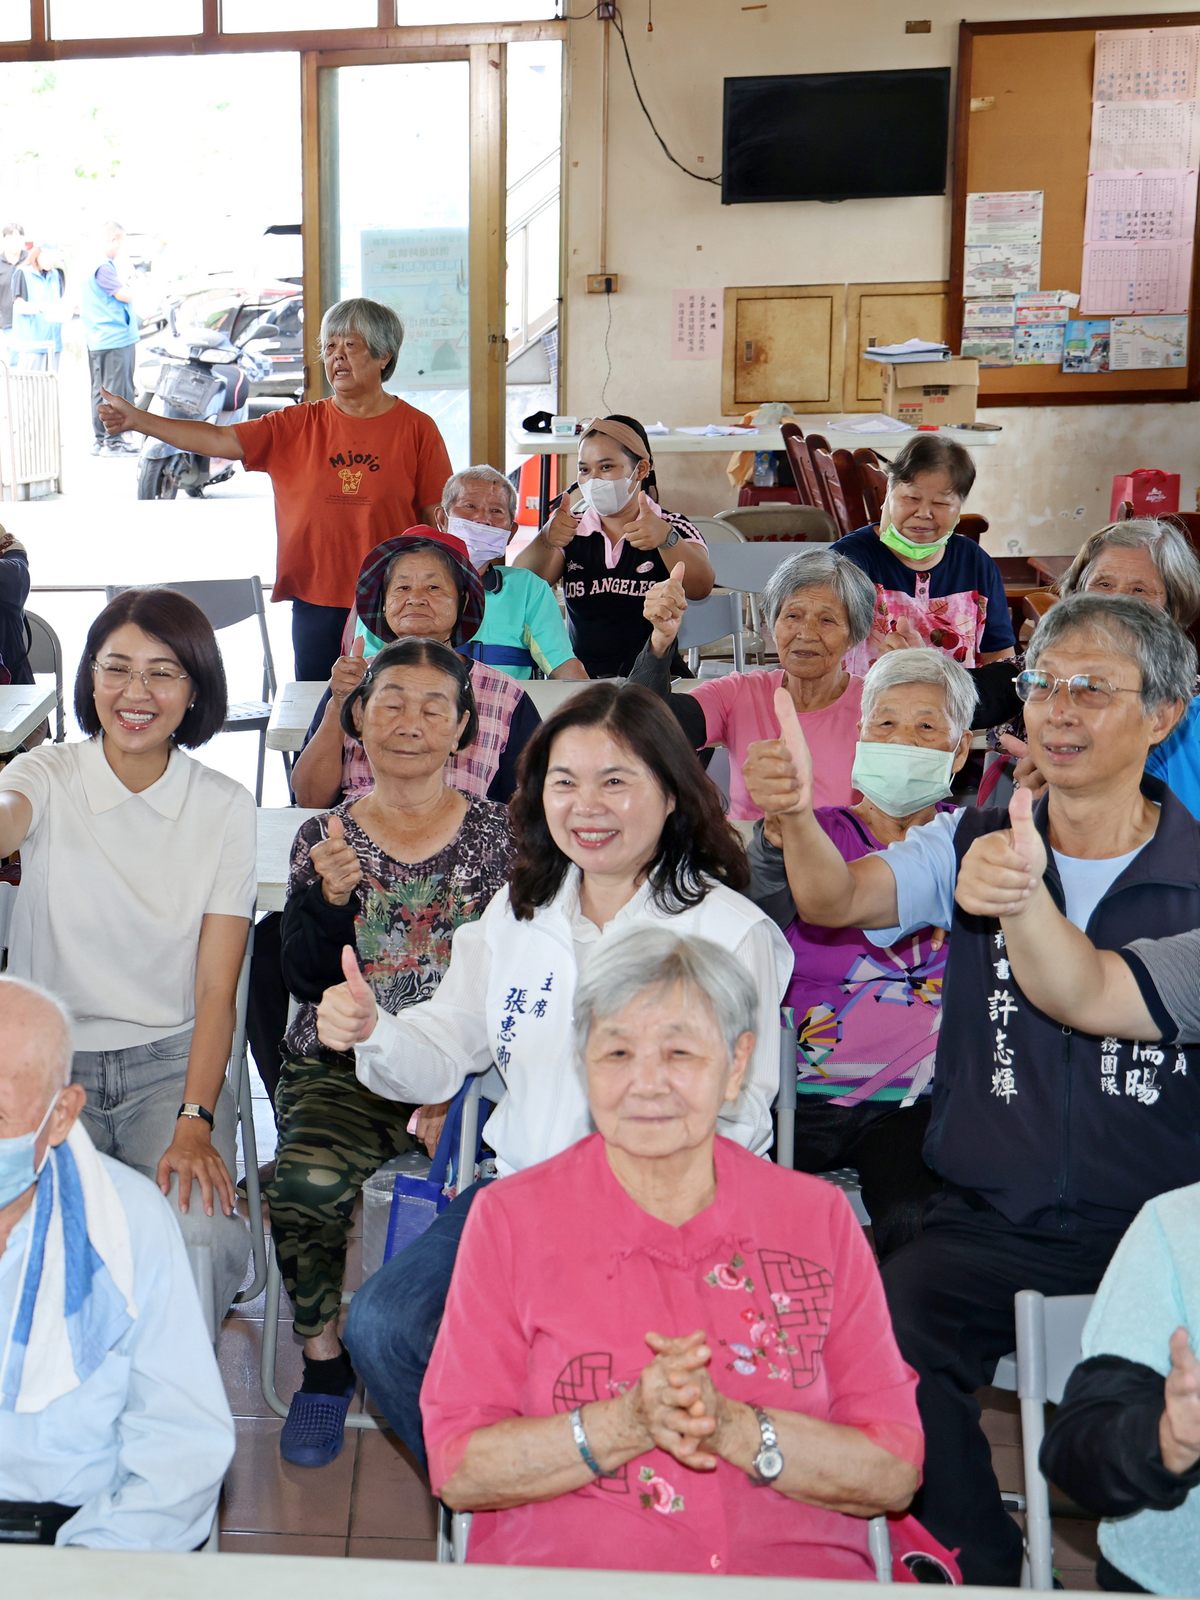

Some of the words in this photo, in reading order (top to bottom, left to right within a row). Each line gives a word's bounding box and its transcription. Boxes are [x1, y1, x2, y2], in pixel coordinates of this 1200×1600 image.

[565, 581, 585, 598] LOS
[528, 972, 553, 1018] 主席
[987, 989, 1019, 1105] 許志輝
